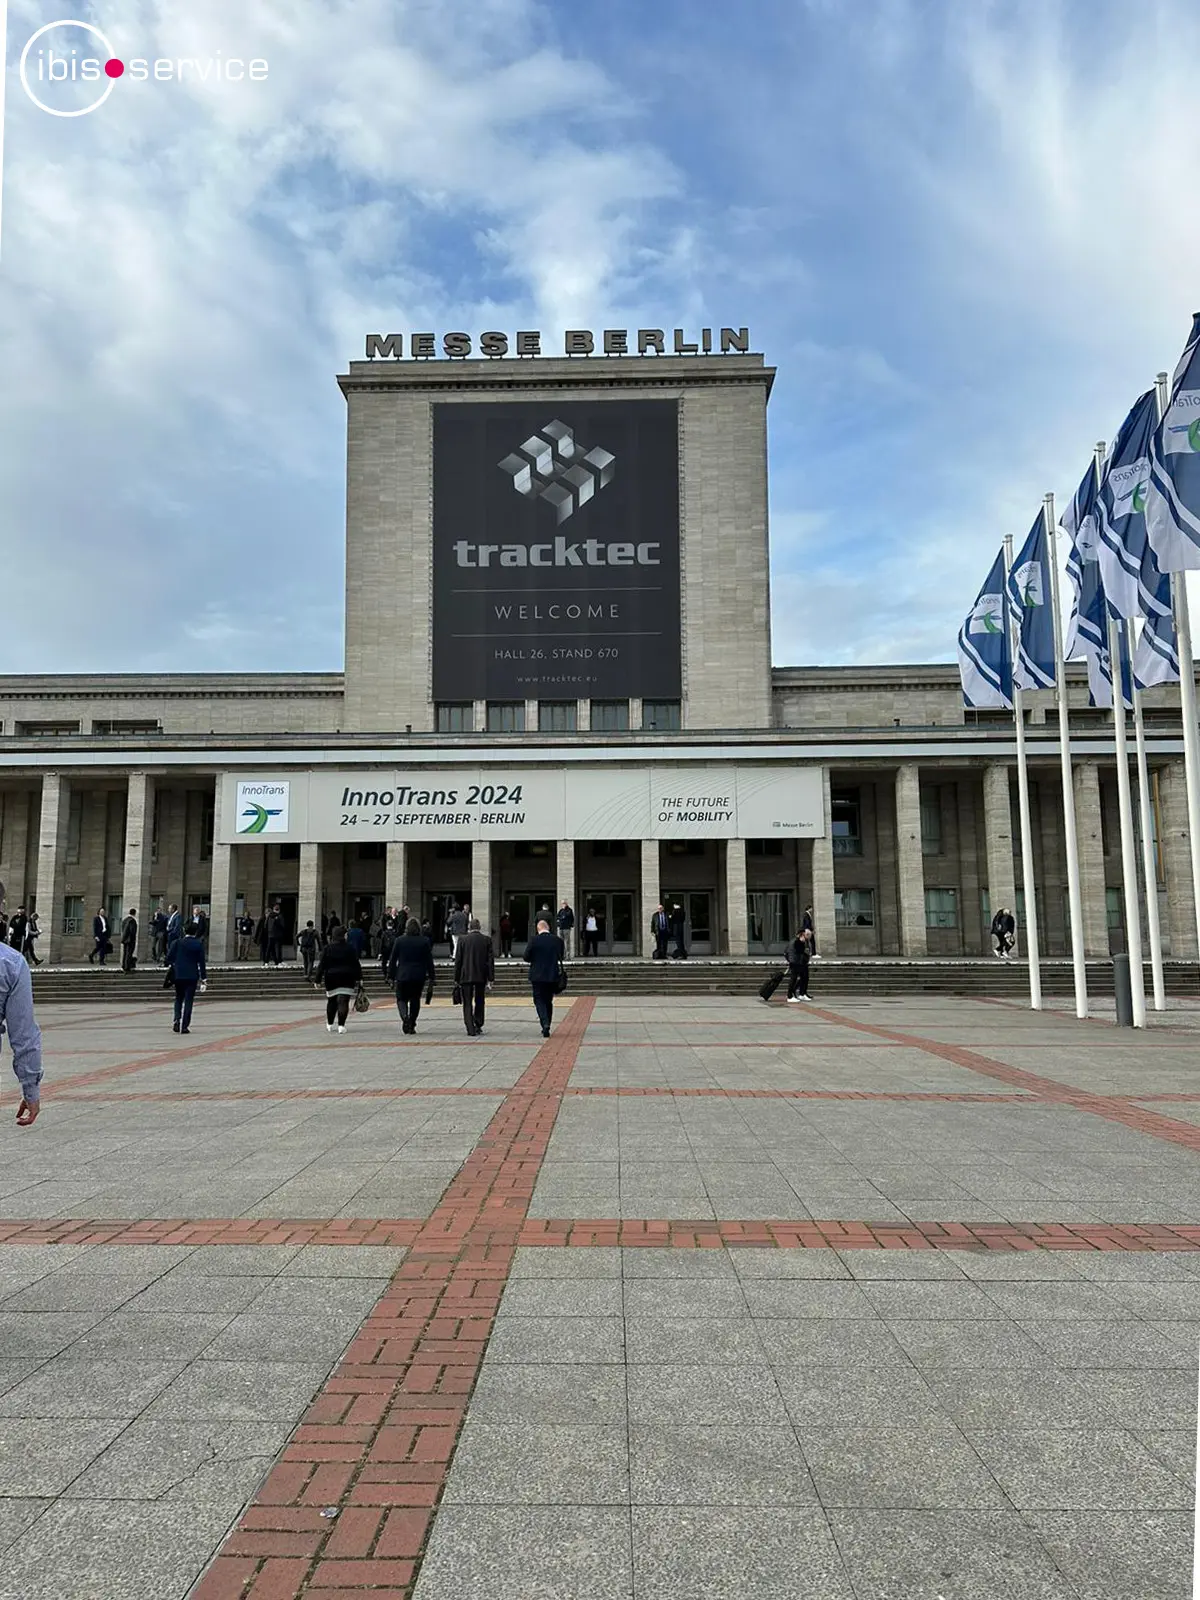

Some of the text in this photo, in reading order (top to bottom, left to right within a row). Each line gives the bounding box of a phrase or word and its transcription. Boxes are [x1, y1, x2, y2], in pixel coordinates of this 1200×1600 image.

[366, 328, 749, 358] MESSE BERLIN
[452, 536, 660, 567] tracktec
[495, 604, 619, 619] WELCOME
[494, 649, 525, 659] HALL
[552, 648, 593, 659] STAND
[598, 648, 619, 658] 670
[517, 674, 598, 682] www.tracktec.eu
[242, 785, 285, 795] InnoTrans
[341, 785, 522, 806] InnoTrans 2024
[662, 797, 730, 807] THE FUTURE
[340, 814, 357, 826] 24
[373, 814, 390, 826] 27
[394, 813, 470, 825] SEPTEMBER
[480, 813, 525, 824] BERLIN
[658, 812, 733, 822] OF MOBILITY
